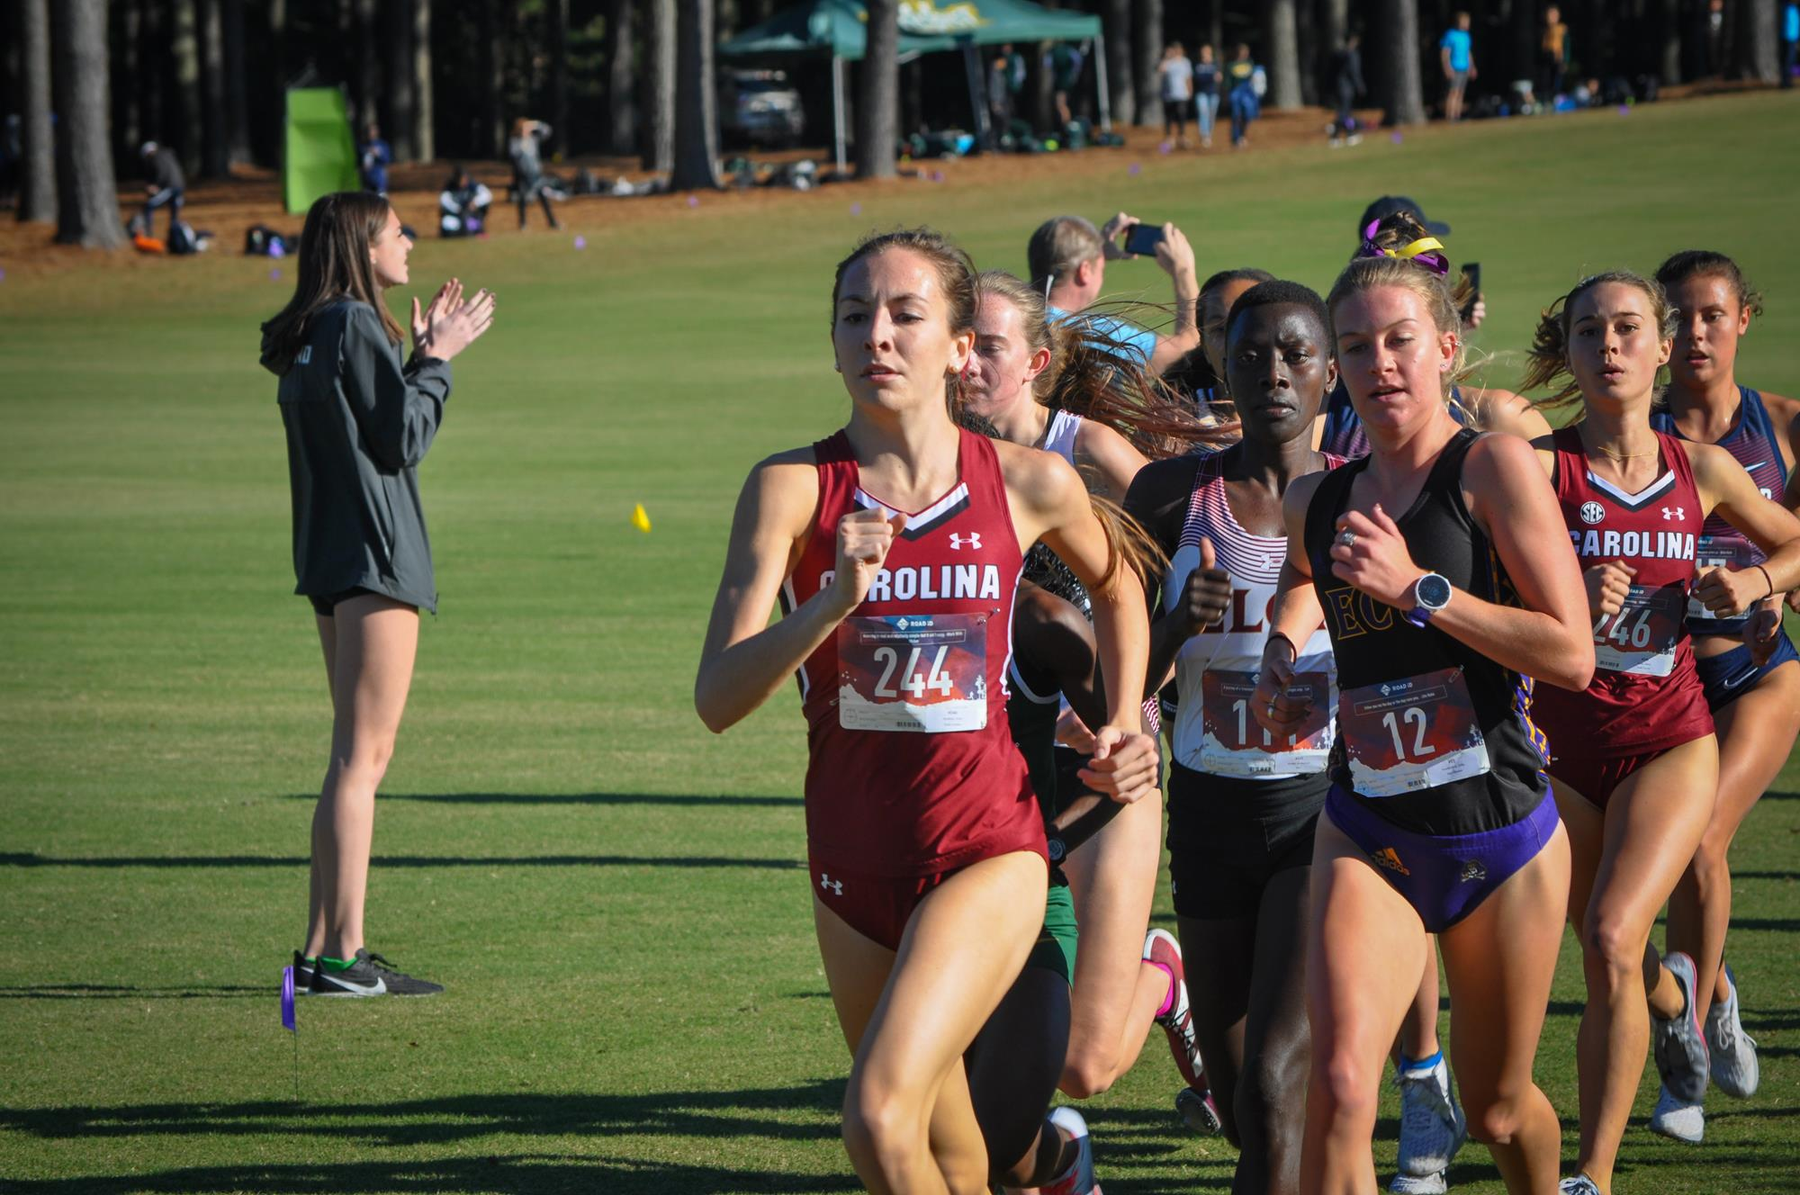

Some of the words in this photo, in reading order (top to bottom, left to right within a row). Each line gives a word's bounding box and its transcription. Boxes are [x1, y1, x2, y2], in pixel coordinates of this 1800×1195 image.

[1582, 503, 1603, 522] SEC
[819, 564, 1001, 603] ROLINA
[873, 645, 954, 699] 244
[1382, 707, 1436, 760] 12
